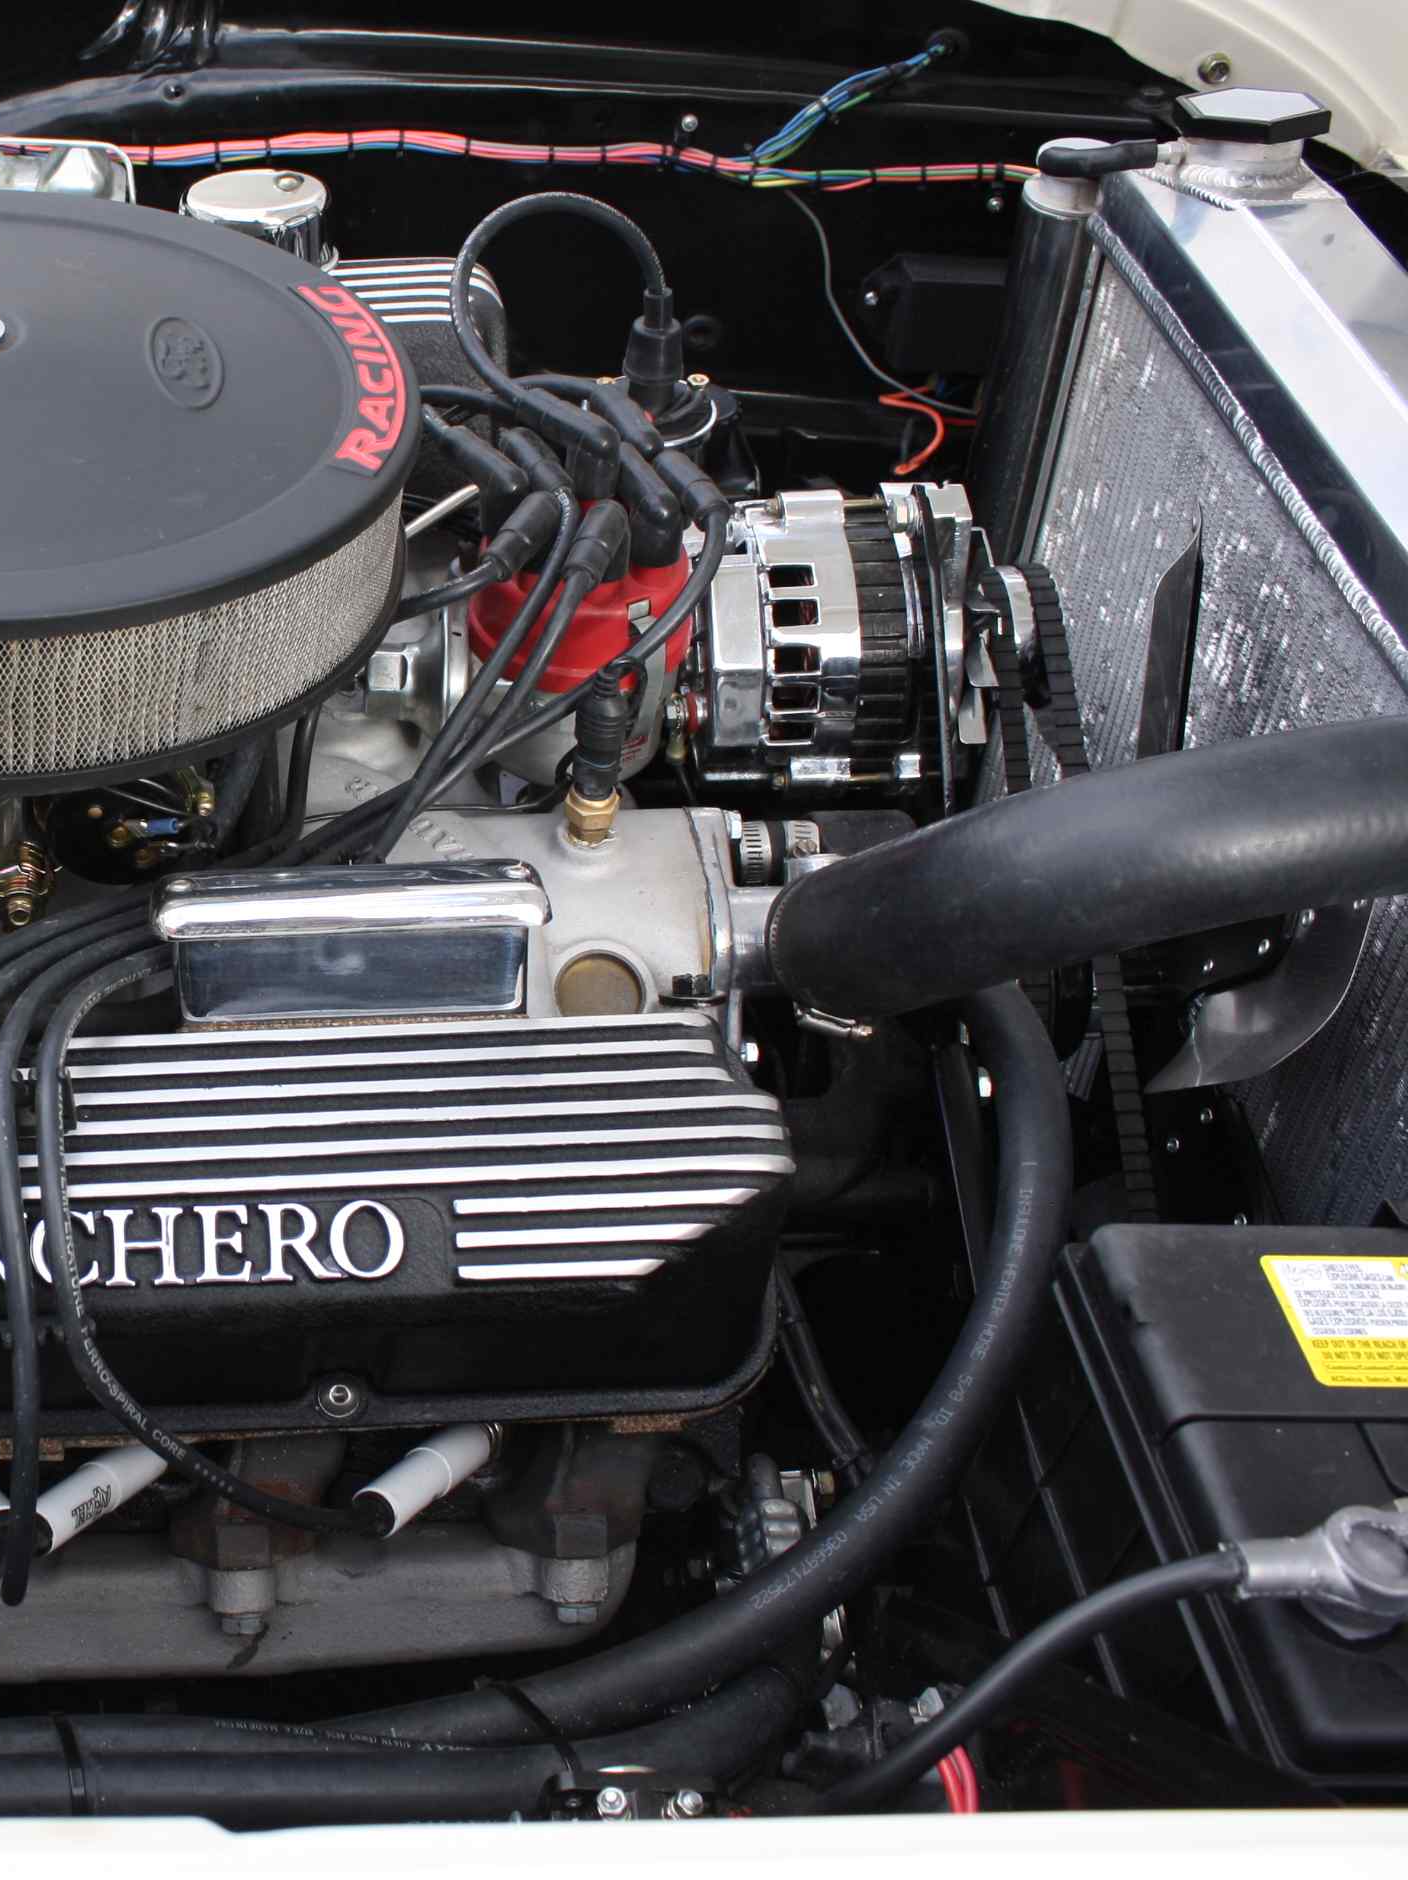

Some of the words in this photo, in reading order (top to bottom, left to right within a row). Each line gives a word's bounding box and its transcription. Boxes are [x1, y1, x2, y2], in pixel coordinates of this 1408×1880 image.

[295, 285, 406, 471] RACING
[991, 1264, 1019, 1318] HEATER
[151, 1427, 187, 1461] CORE
